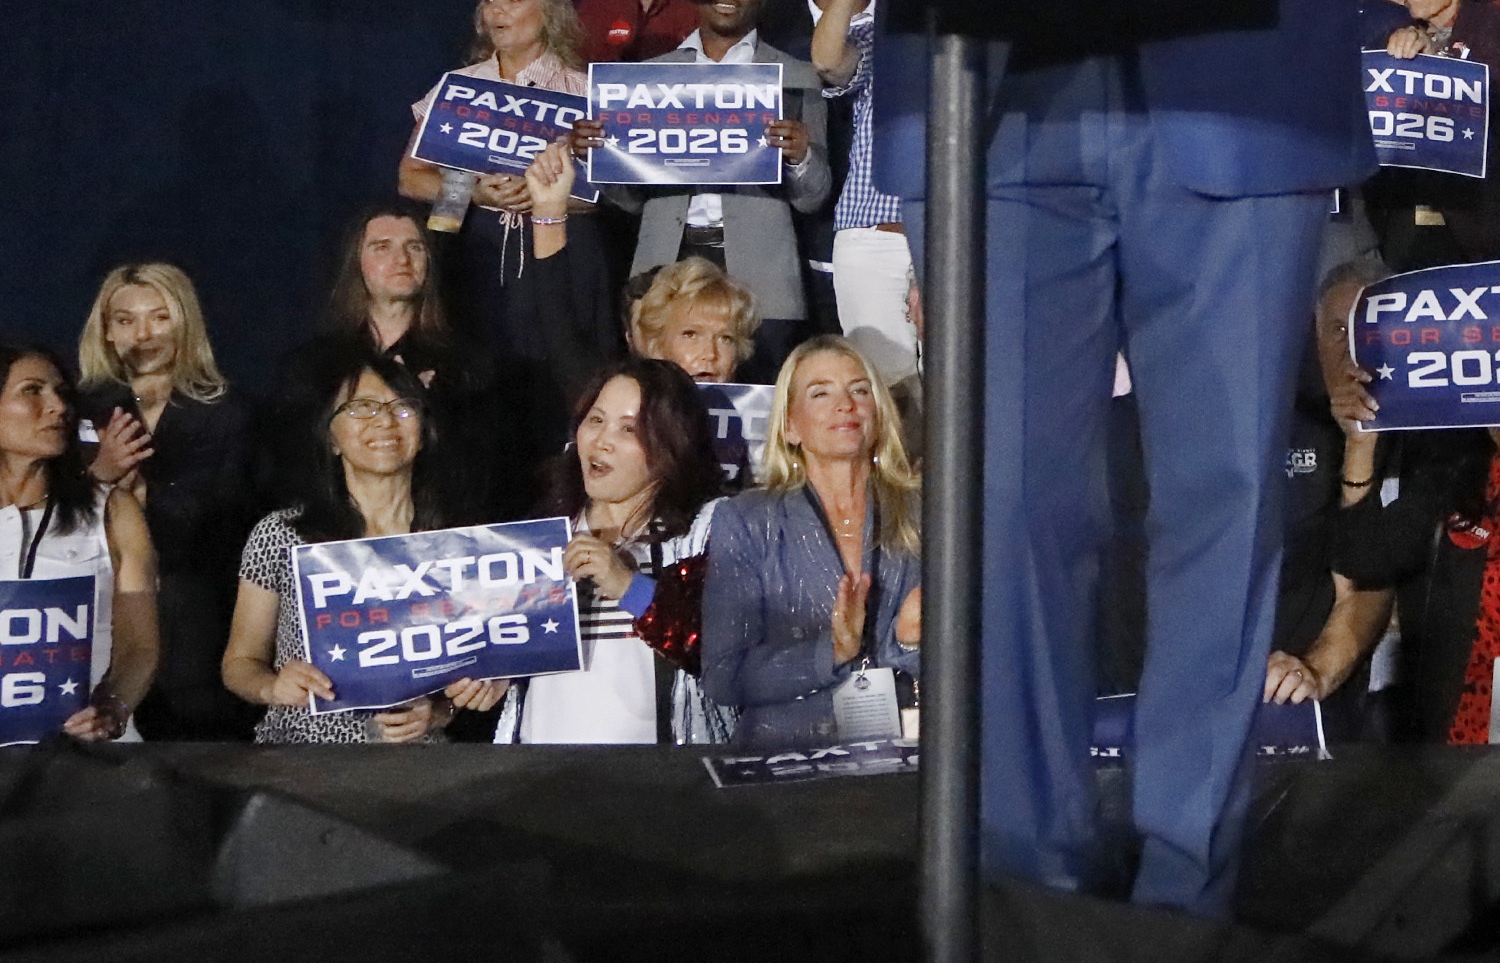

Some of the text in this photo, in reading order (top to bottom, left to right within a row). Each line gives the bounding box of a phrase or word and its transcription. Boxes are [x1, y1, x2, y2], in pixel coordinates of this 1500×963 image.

[597, 84, 775, 109] PAXTON
[1365, 68, 1482, 104] XTON
[445, 85, 588, 129] PAXTO
[599, 113, 651, 124] FOR
[458, 122, 547, 158] 202
[628, 129, 748, 153] 2026
[1368, 110, 1454, 142] 026
[1366, 328, 1440, 346] FOR
[307, 547, 564, 608] PAXTON
[316, 586, 566, 630] FOR SETE
[357, 614, 530, 667] 2026
